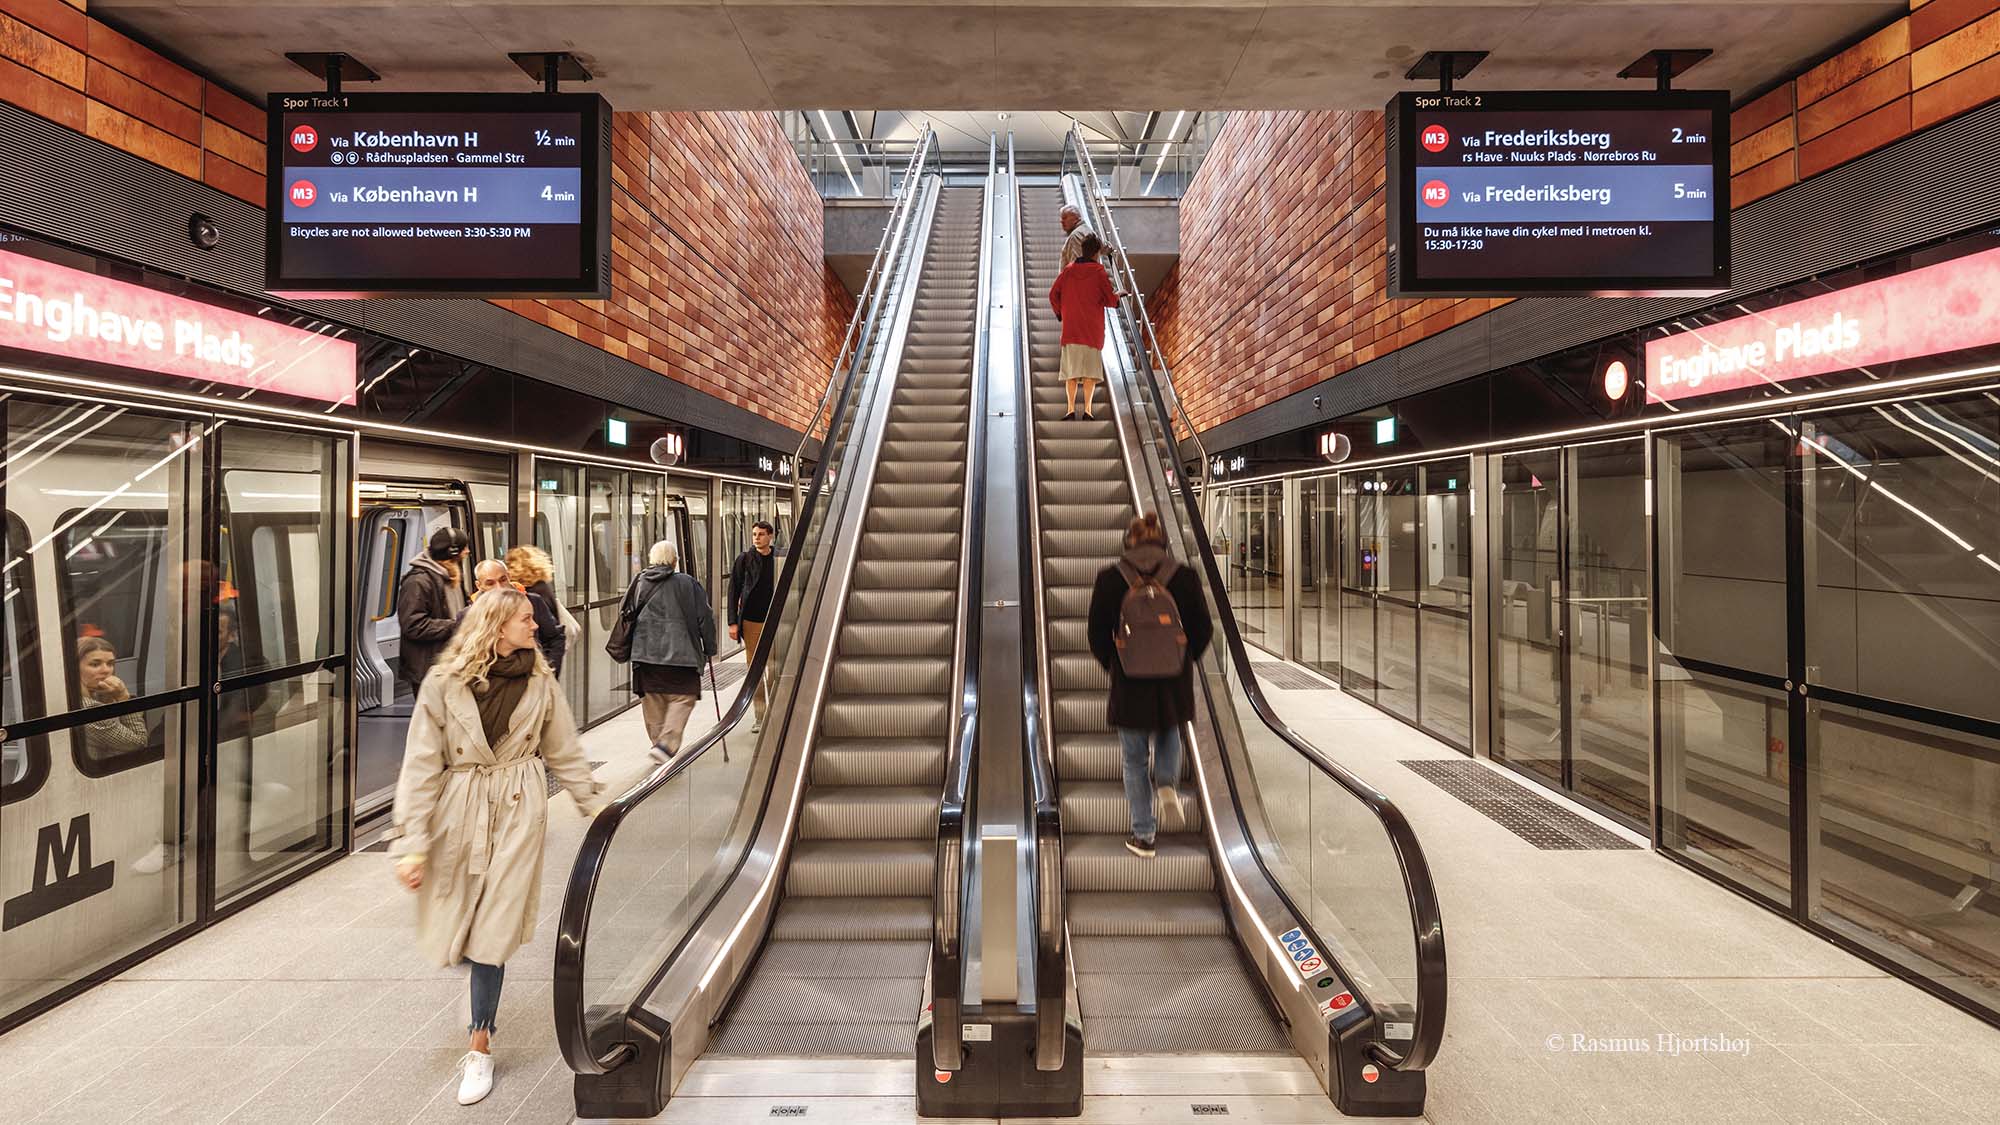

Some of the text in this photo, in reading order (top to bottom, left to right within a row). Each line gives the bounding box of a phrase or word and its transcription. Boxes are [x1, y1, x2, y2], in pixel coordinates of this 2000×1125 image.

[283, 98, 349, 109] Spor Track 1
[1415, 97, 1482, 108] Spor Track 2
[294, 133, 315, 145] M3
[330, 137, 349, 147] Via
[354, 131, 459, 147] København
[465, 132, 478, 147] H
[555, 137, 575, 146] min
[1425, 128, 1706, 149] M3 Via Frederiksberg 2 min
[366, 152, 449, 165] Rådhuspladsen
[456, 153, 502, 164] Gammel
[1462, 151, 1656, 162] rs Have Nuuks Plads Nørrebros Ru
[292, 185, 575, 202] M3 Via København H 4 min
[1425, 183, 1706, 205] M3 Via Frederiksberg 5 min
[290, 227, 531, 238] Bicycles are not allowed between 3:30-5:30 PM
[1424, 227, 1438, 237] Du
[1441, 225, 1458, 237] må
[1461, 226, 1482, 237] ikke
[1485, 226, 1509, 237] have
[1512, 226, 1529, 237] din
[1531, 226, 1557, 239] cykel
[1560, 226, 1582, 236] med
[1592, 227, 1636, 236] metroen
[1639, 226, 1652, 236] kl.
[1424, 240, 1483, 250] 15:30-17:30
[0, 278, 255, 368] Enghave Plads
[1659, 312, 1860, 387] Enghave Plads
